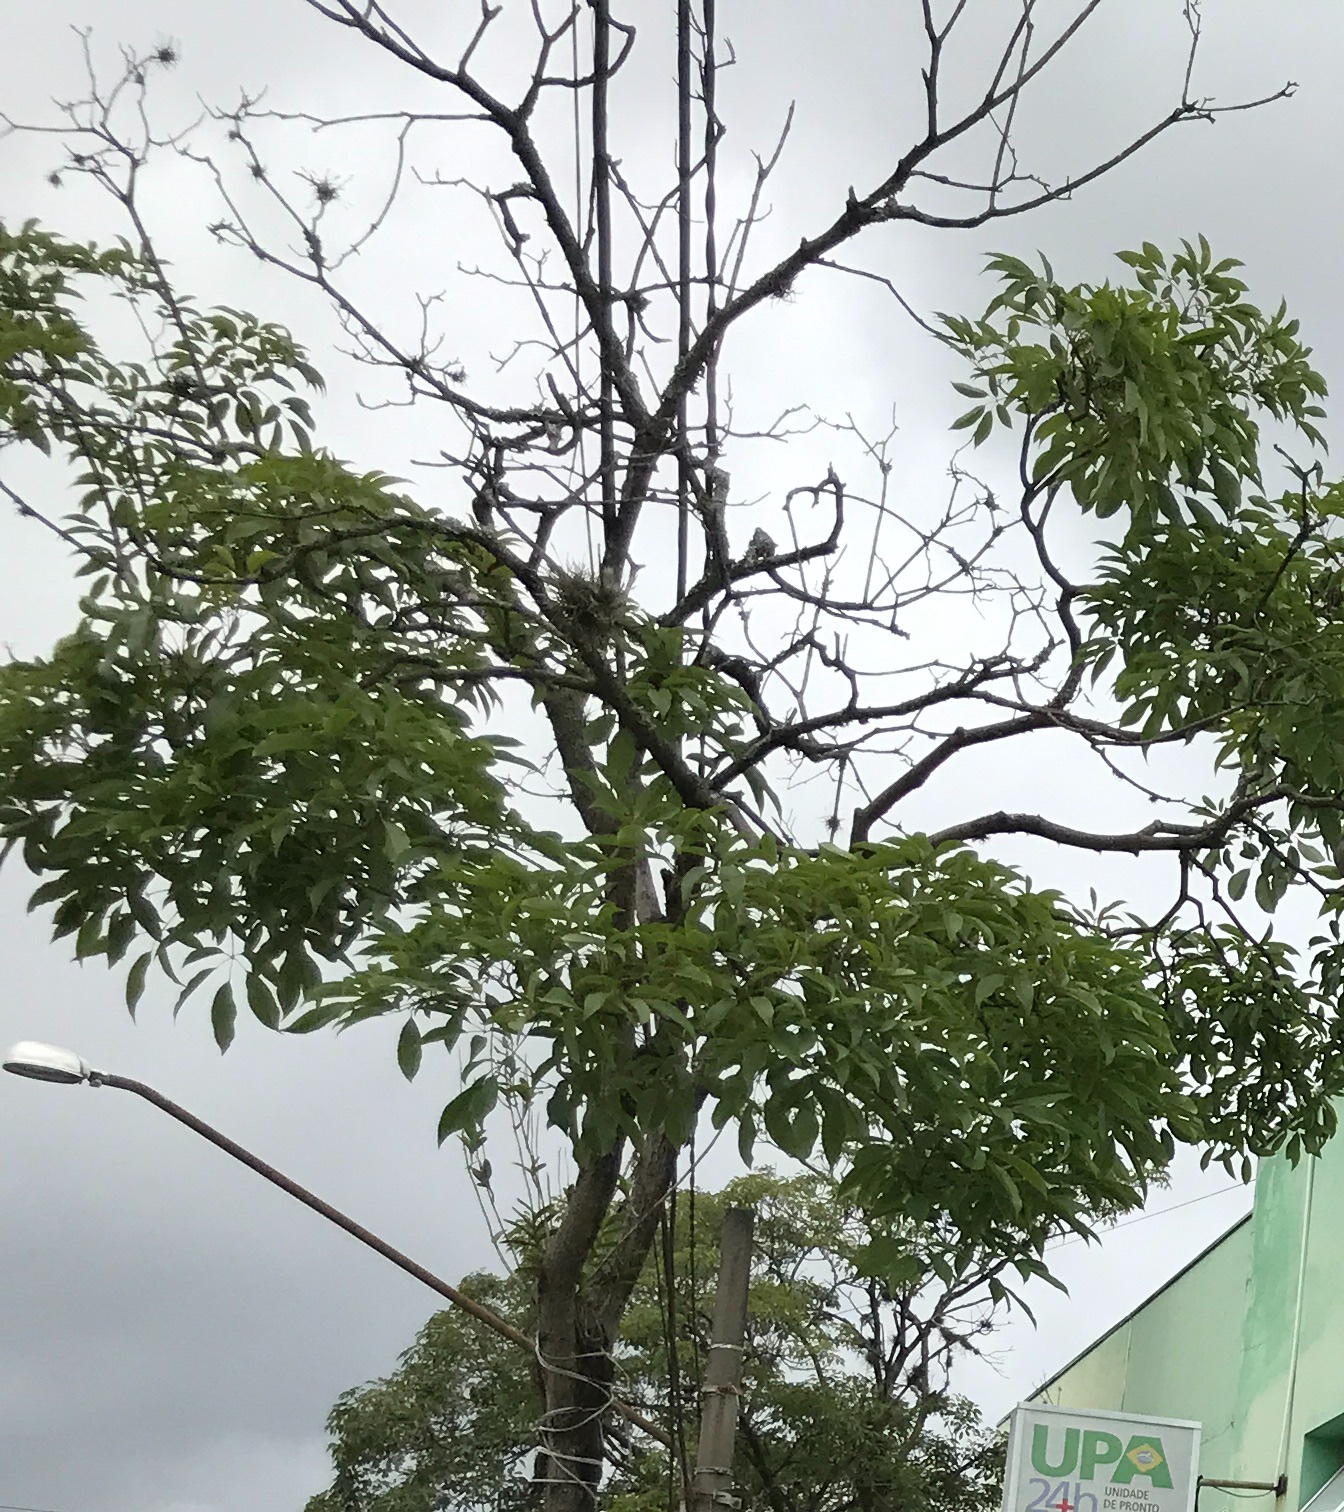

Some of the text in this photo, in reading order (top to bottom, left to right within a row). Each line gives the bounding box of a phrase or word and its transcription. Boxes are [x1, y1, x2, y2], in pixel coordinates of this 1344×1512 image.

[1030, 1423, 1175, 1490] UPA
[1104, 1486, 1150, 1501] UNIDADE
[1103, 1498, 1117, 1510] DE
